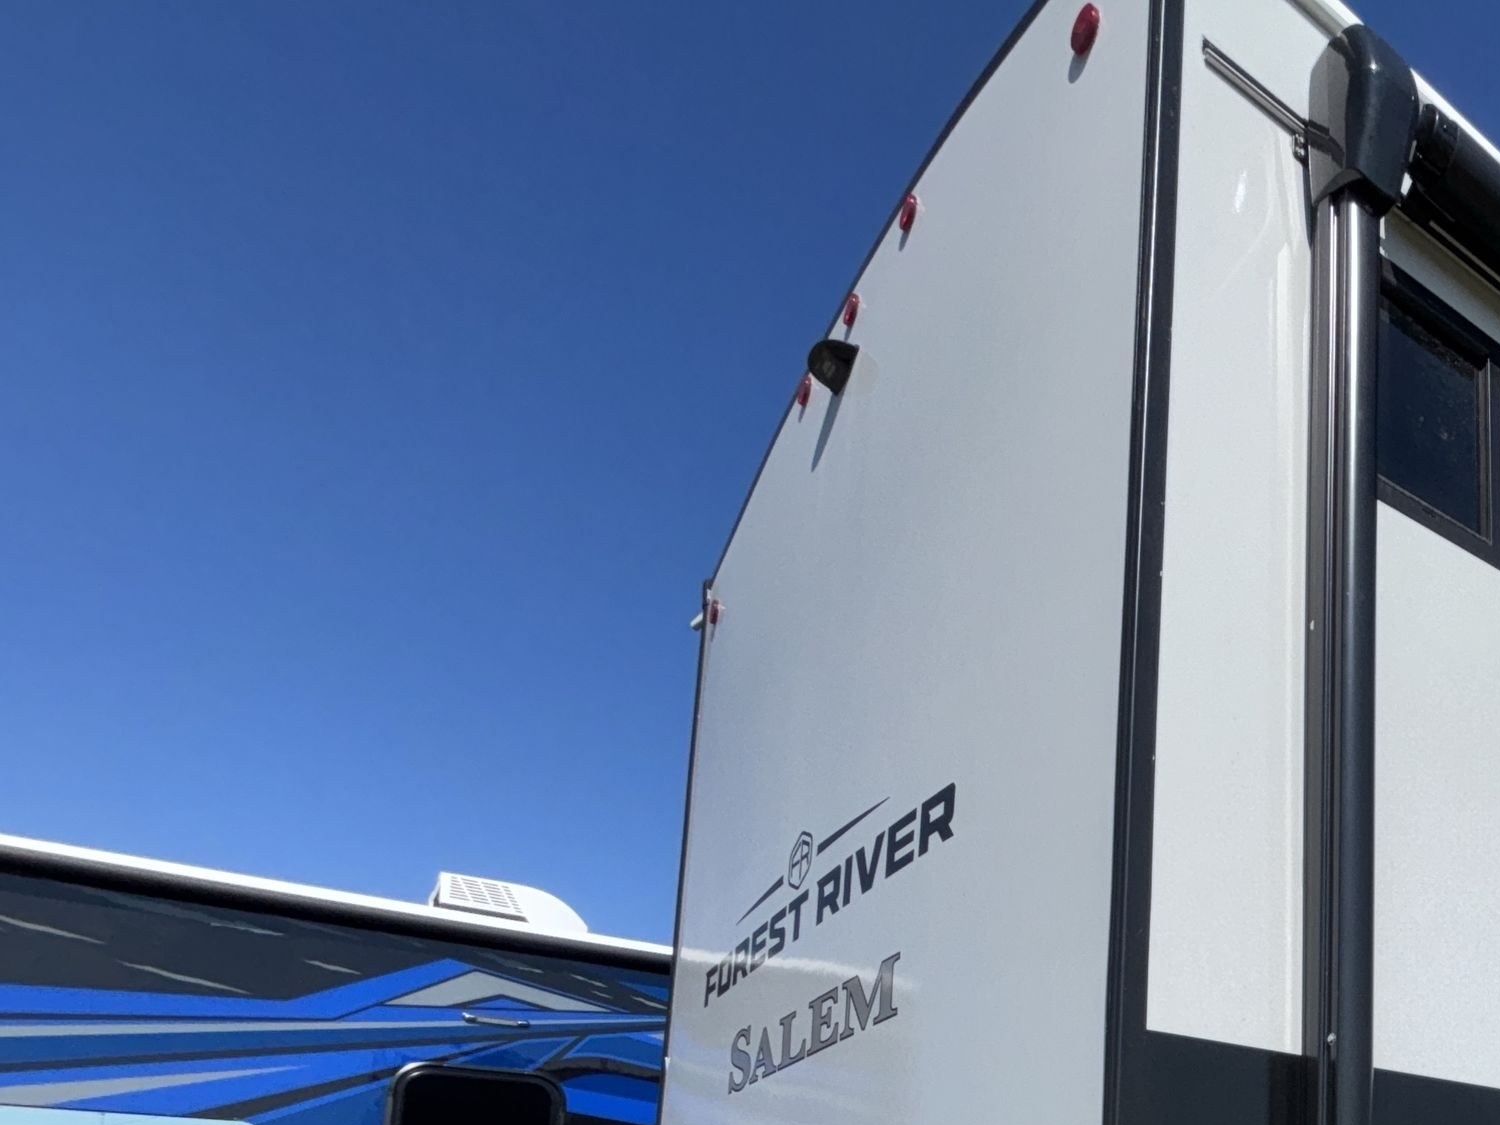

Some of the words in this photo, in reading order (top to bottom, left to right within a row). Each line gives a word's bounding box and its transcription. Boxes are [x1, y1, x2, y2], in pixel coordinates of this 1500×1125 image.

[704, 889, 810, 1008] FOREST
[816, 782, 957, 926] RIVER
[728, 951, 901, 1095] SALEM
